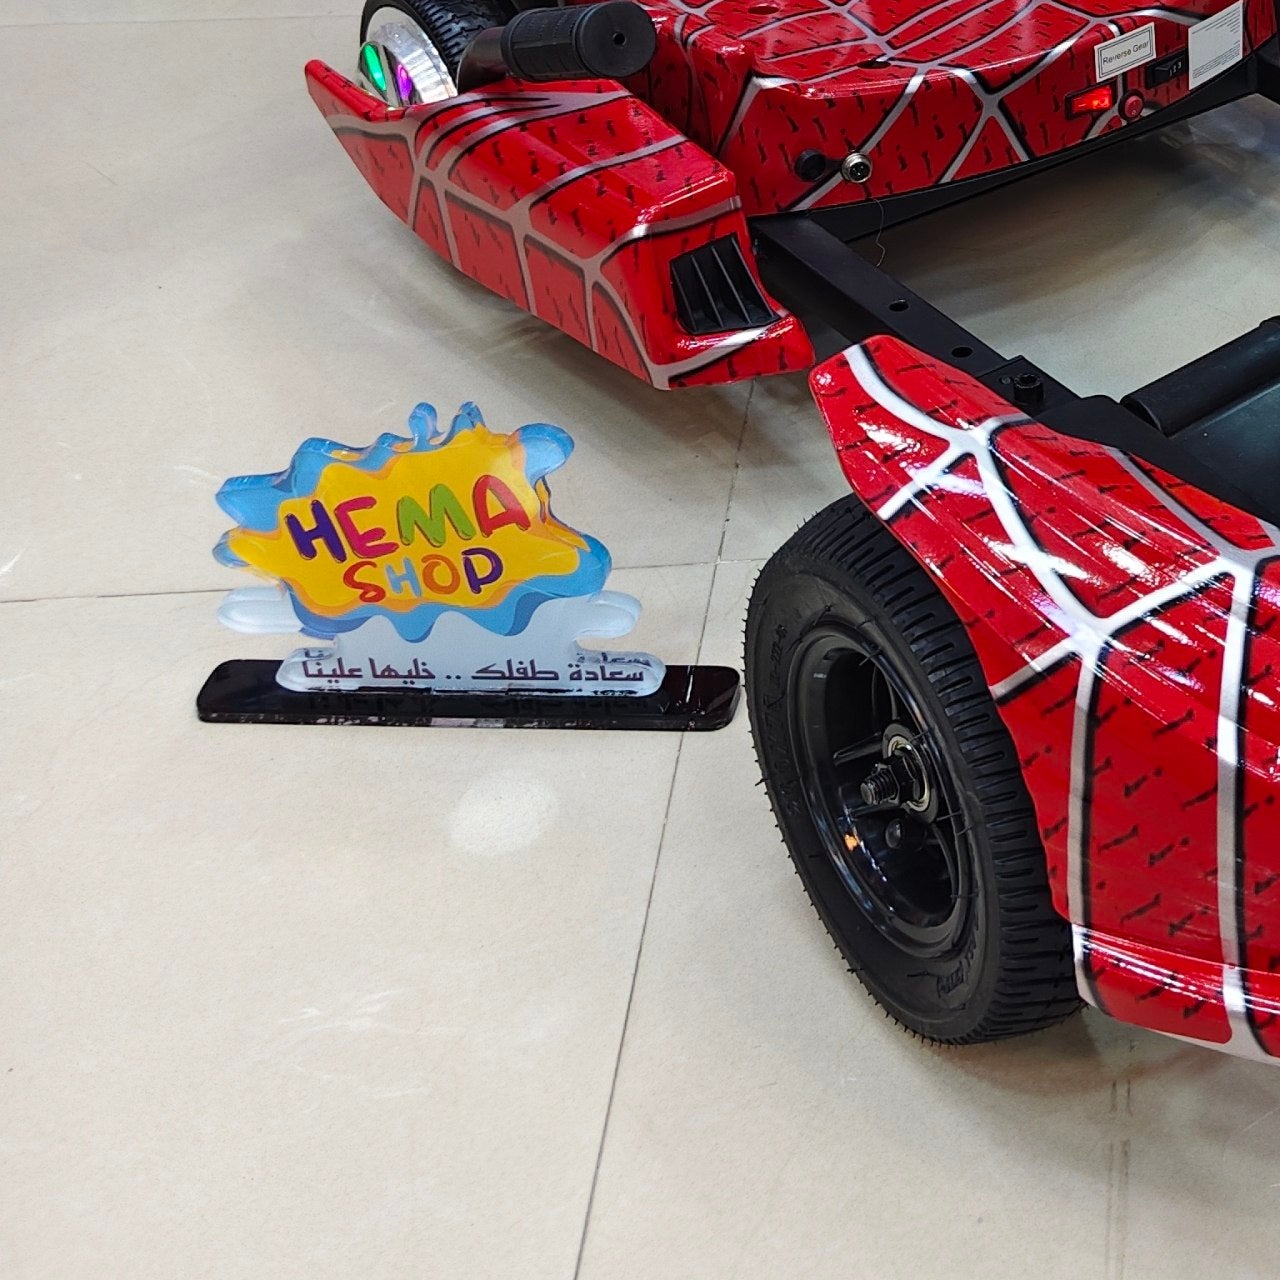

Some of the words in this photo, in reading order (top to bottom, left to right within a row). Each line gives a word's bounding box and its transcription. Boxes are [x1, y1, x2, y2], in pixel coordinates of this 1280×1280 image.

[1132, 39, 1150, 53] Gear
[284, 474, 532, 564] HEMA
[343, 547, 505, 603] SHOP
[471, 658, 560, 682] طفلك
[568, 662, 645, 682] سعادة
